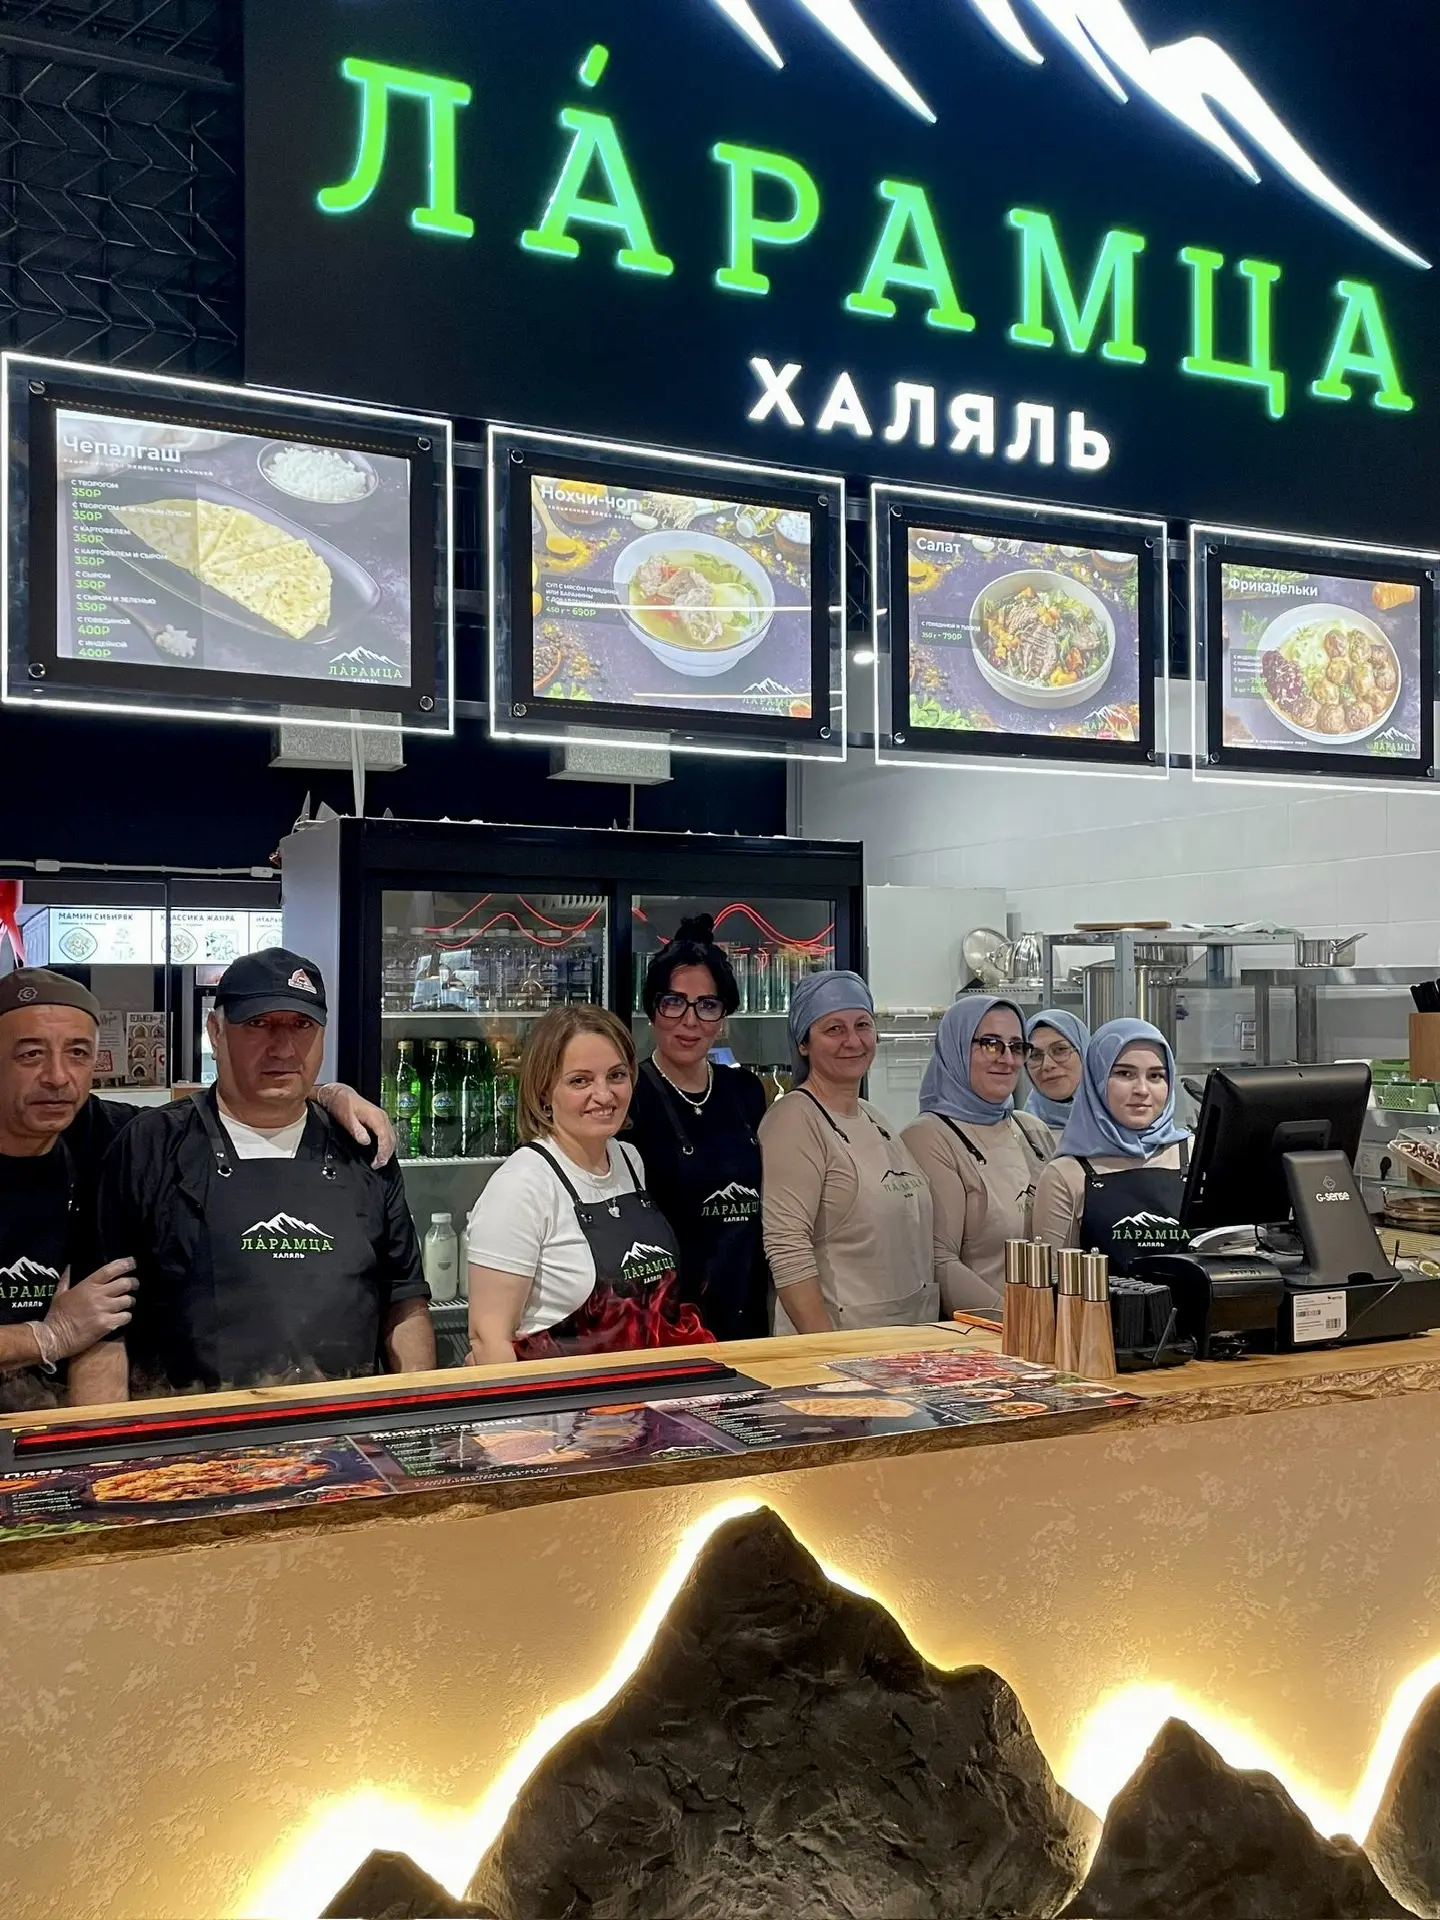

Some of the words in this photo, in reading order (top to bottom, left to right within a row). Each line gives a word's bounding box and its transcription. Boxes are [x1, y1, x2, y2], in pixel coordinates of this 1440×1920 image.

[748, 356, 1112, 472] ХАЛЯЛЬ
[63, 435, 181, 463] Чепалгаш
[78, 479, 119, 489] ТВОРОГОМ
[916, 537, 962, 554] Салат
[1229, 578, 1318, 596] Фрикадельки
[160, 914, 204, 922] КАССИКА
[1315, 1191, 1351, 1203] G-sense
[272, 1252, 306, 1260] ХАЛЯЛЬ
[11, 1300, 43, 1309] ХАЛЯЛЬ
